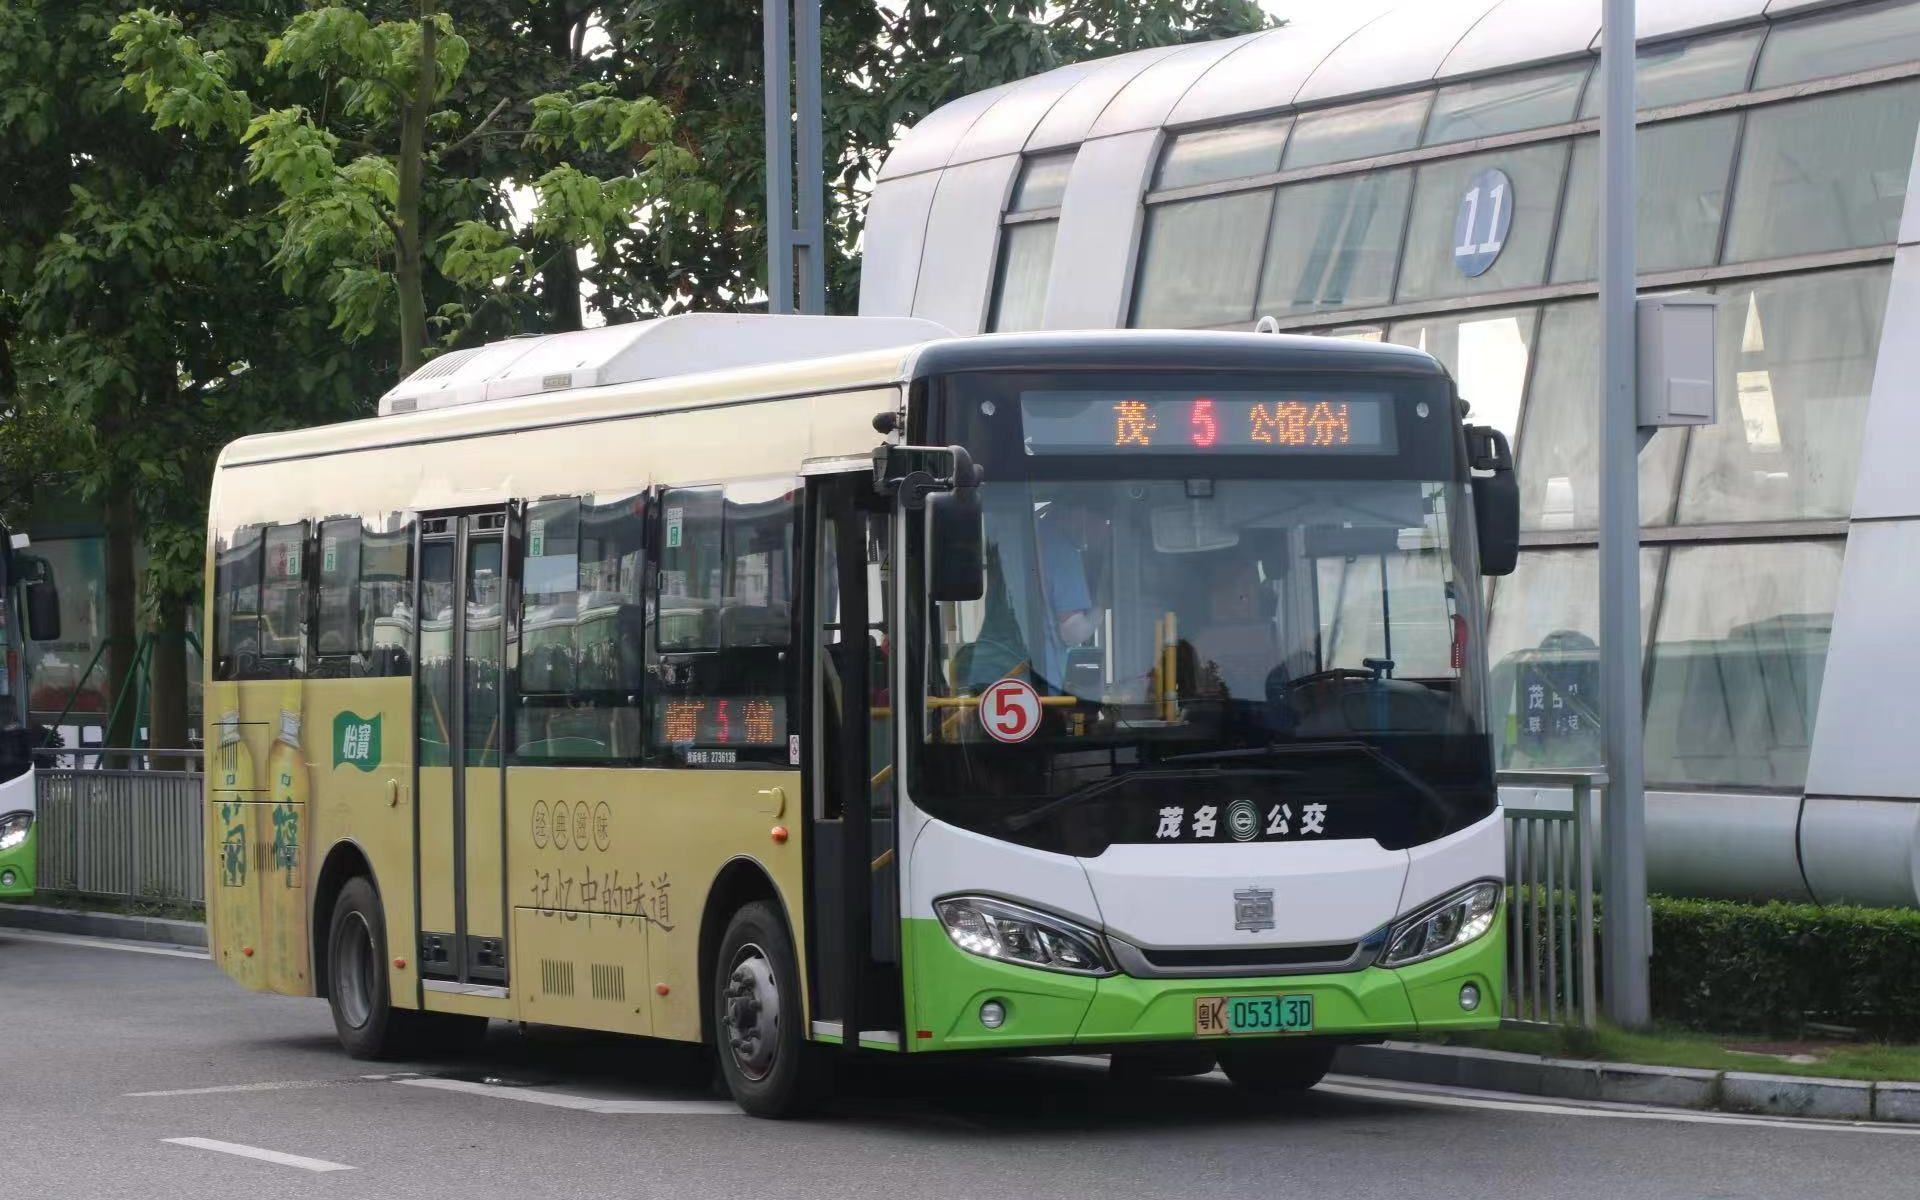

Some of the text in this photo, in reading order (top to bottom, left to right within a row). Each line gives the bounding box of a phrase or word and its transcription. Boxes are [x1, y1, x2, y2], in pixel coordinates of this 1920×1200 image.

[1456, 184, 1504, 256] 11
[1191, 400, 1217, 447] 5
[718, 700, 729, 743] 5
[995, 688, 1028, 735] 5
[1156, 803, 1328, 839] 茂名 公交
[531, 865, 675, 932] 记忆中的味道
